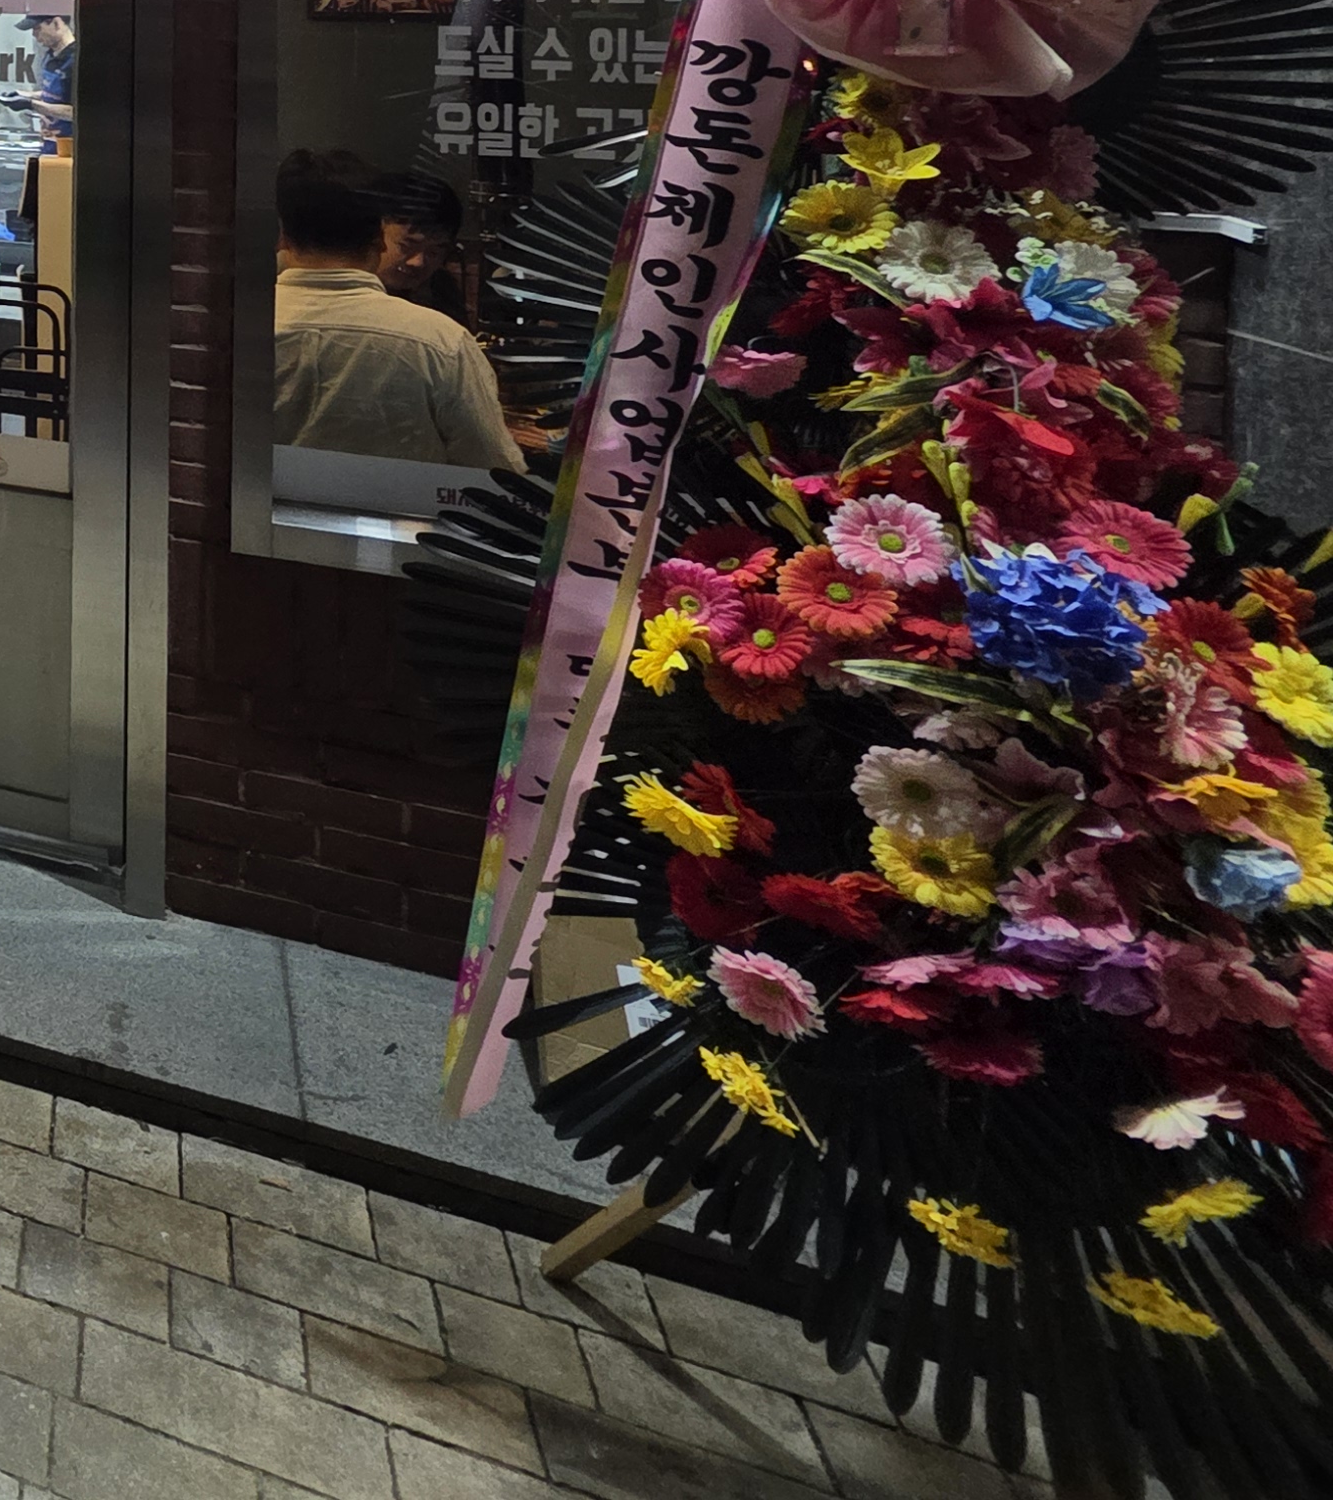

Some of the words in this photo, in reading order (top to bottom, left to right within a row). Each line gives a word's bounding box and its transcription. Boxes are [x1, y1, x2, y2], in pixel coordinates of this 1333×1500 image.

[433, 25, 516, 81] 드실
[531, 28, 574, 82] 수
[433, 102, 560, 159] 유일한
